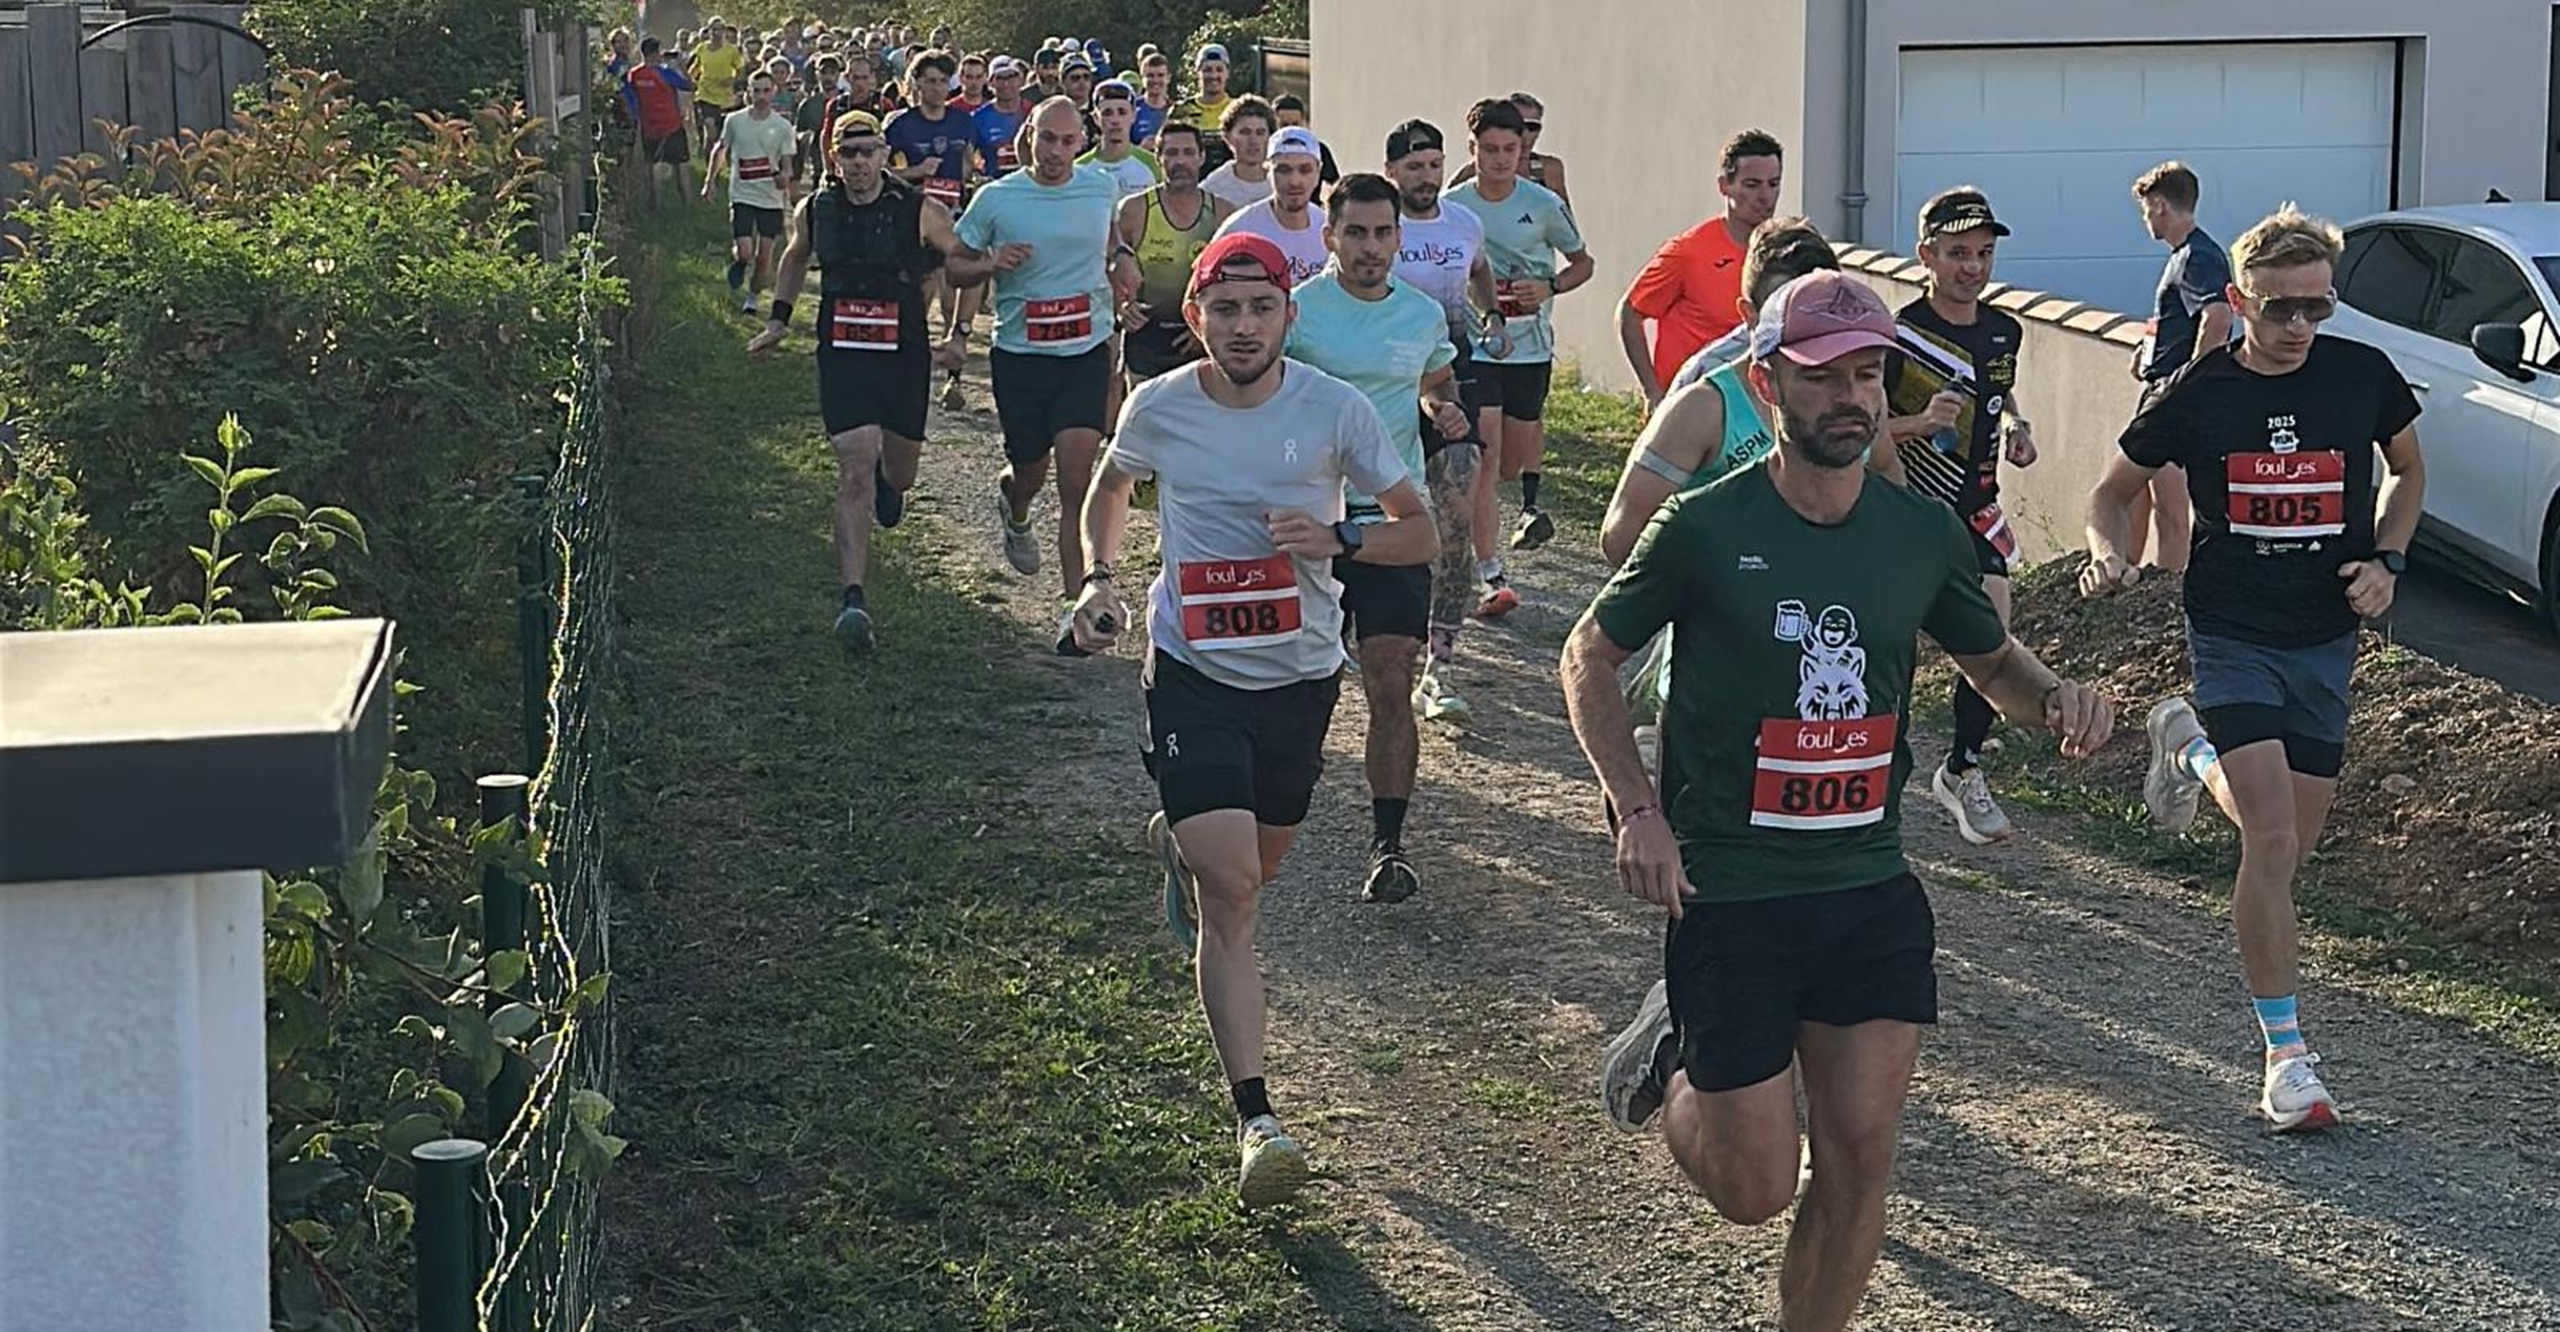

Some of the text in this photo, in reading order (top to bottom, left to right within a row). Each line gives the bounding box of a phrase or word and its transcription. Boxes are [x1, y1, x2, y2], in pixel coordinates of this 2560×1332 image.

[2267, 414, 2296, 429] 2025
[1726, 430, 1771, 471] ASPM
[2250, 496, 2323, 525] 805
[1205, 600, 1280, 636] 808
[1781, 774, 1869, 812] 806
